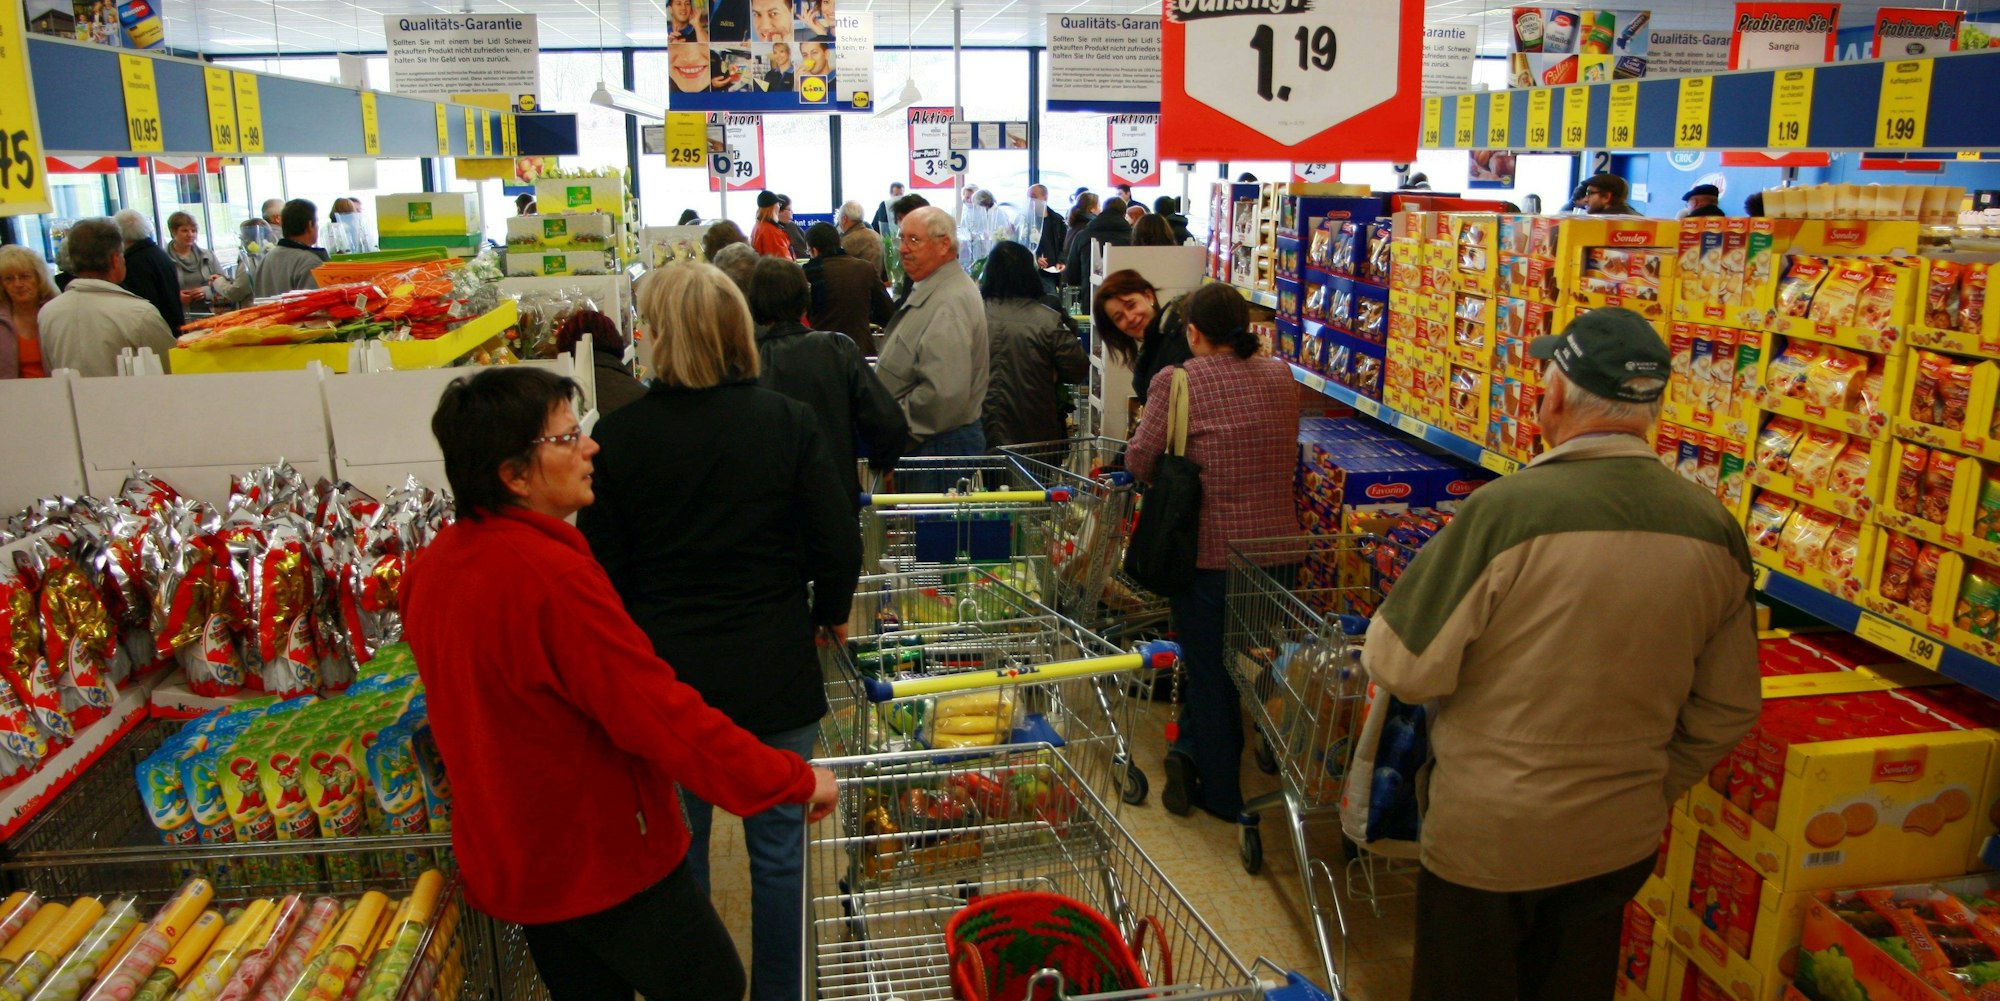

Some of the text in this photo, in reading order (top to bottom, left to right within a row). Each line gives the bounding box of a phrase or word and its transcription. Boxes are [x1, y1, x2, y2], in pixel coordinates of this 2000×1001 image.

[399, 17, 523, 31] Qualitäts-Garantie
[1737, 7, 1838, 33] Probieren Sie!
[1878, 14, 1960, 39] Probieren Sie!
[473, 38, 484, 46] bei
[487, 38, 500, 46] Lidl
[505, 38, 532, 46] Schweiz
[1448, 45, 1471, 53] Schweiz
[1768, 41, 1800, 53] Sangria
[394, 48, 426, 56] gekauften
[428, 47, 454, 55] Produkt
[455, 47, 472, 55] nicht
[473, 47, 505, 55] zufrieden
[1249, 24, 1337, 102] 1.19
[130, 118, 158, 142] 10.95
[215, 123, 232, 145] 1.99
[244, 126, 260, 147] -.99
[1458, 129, 1471, 143] 2.99
[1491, 128, 1505, 142] 2.99
[1531, 127, 1545, 142] 1.59
[1566, 126, 1582, 142] 1.59
[1612, 126, 1628, 142] 1.99
[1680, 123, 1702, 141] 3.29
[1778, 121, 1799, 141] 1.19
[1886, 118, 1915, 140] 1.99
[671, 147, 701, 163] 2.95
[950, 151, 967, 173] 5
[1594, 151, 1610, 175] 2
[713, 153, 732, 174] 6
[733, 161, 753, 178] 79
[925, 159, 948, 176] 3.99
[1120, 158, 1149, 175] -.99
[1613, 232, 1647, 244] Sondey
[1831, 229, 1860, 241] Sondey
[1796, 266, 1817, 275] Sondey
[1842, 271, 1864, 281] Sondey
[1931, 268, 1951, 277] Sondey
[1372, 485, 1404, 495] Favorini
[1908, 635, 1935, 660] 1.99
[1879, 762, 1920, 775] Sondey
